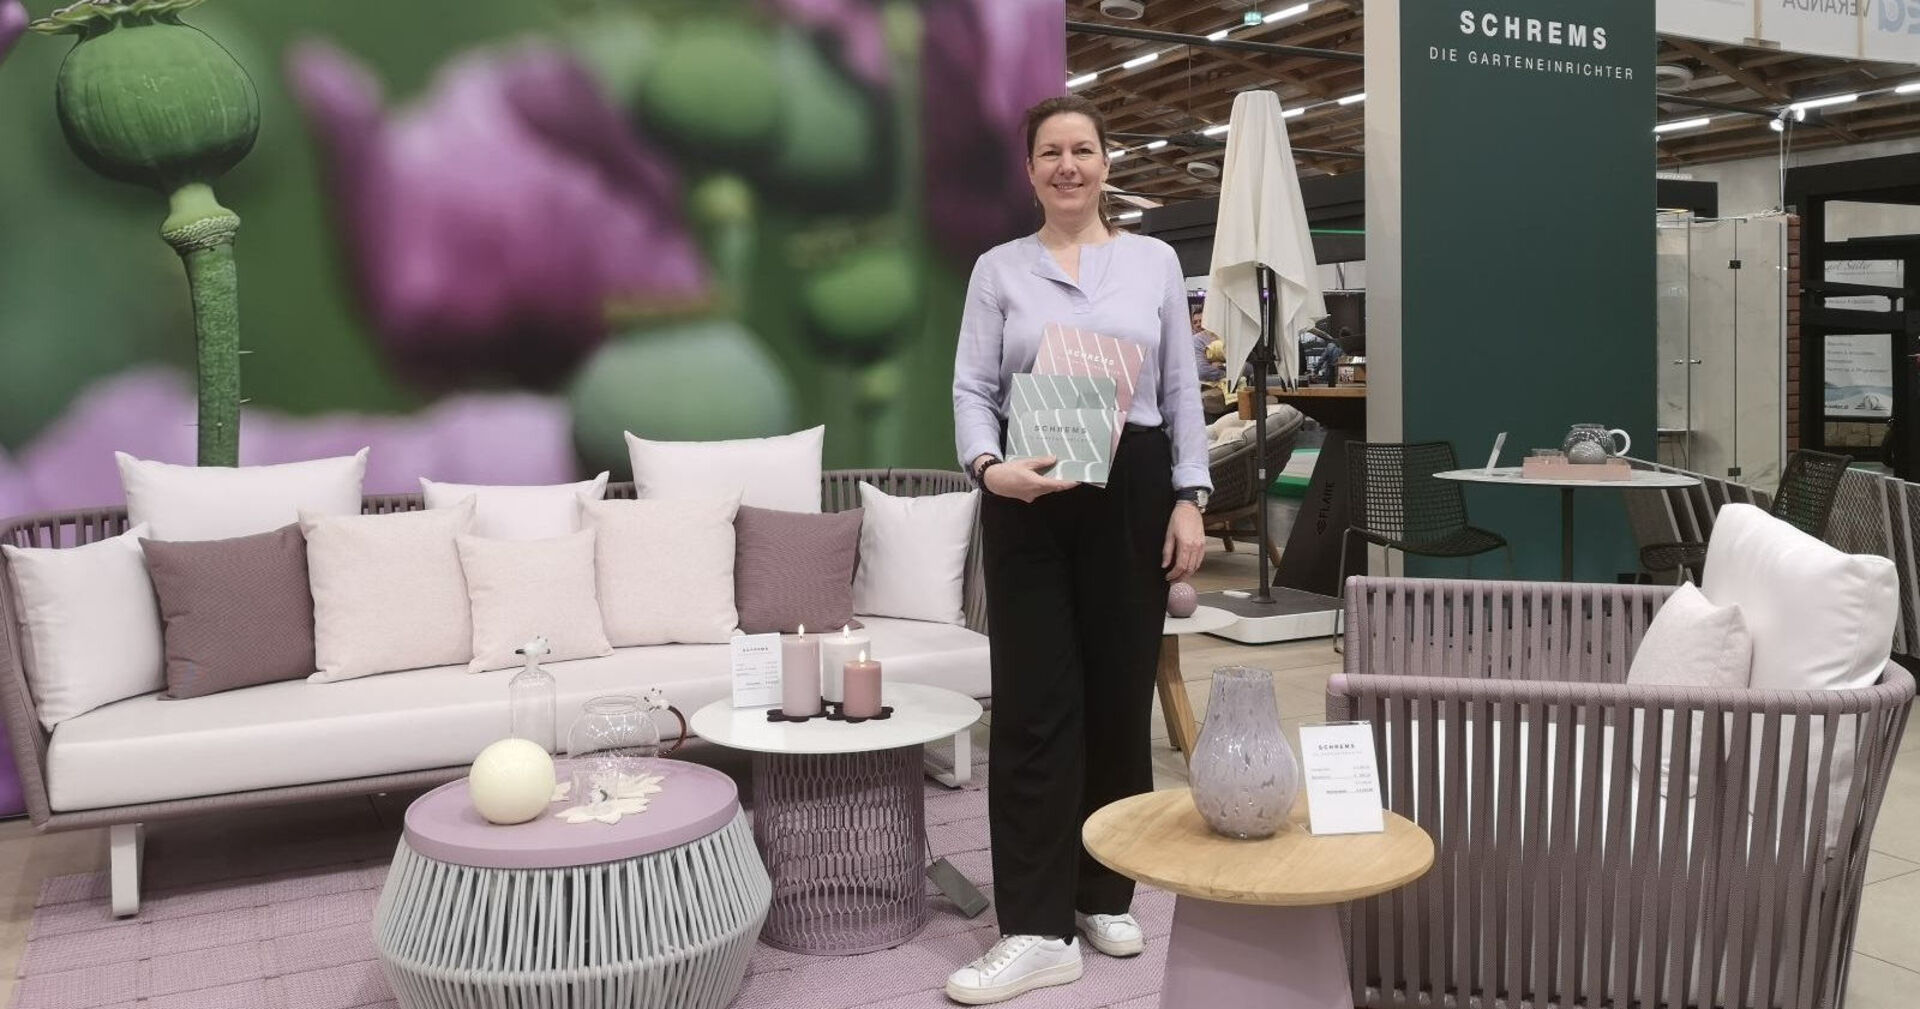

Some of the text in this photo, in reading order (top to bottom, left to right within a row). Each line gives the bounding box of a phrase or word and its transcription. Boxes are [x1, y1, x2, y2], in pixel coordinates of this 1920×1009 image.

[1459, 10, 1608, 50] SCHREMS
[1429, 46, 1634, 80] DIE GARTENEINRICHTER
